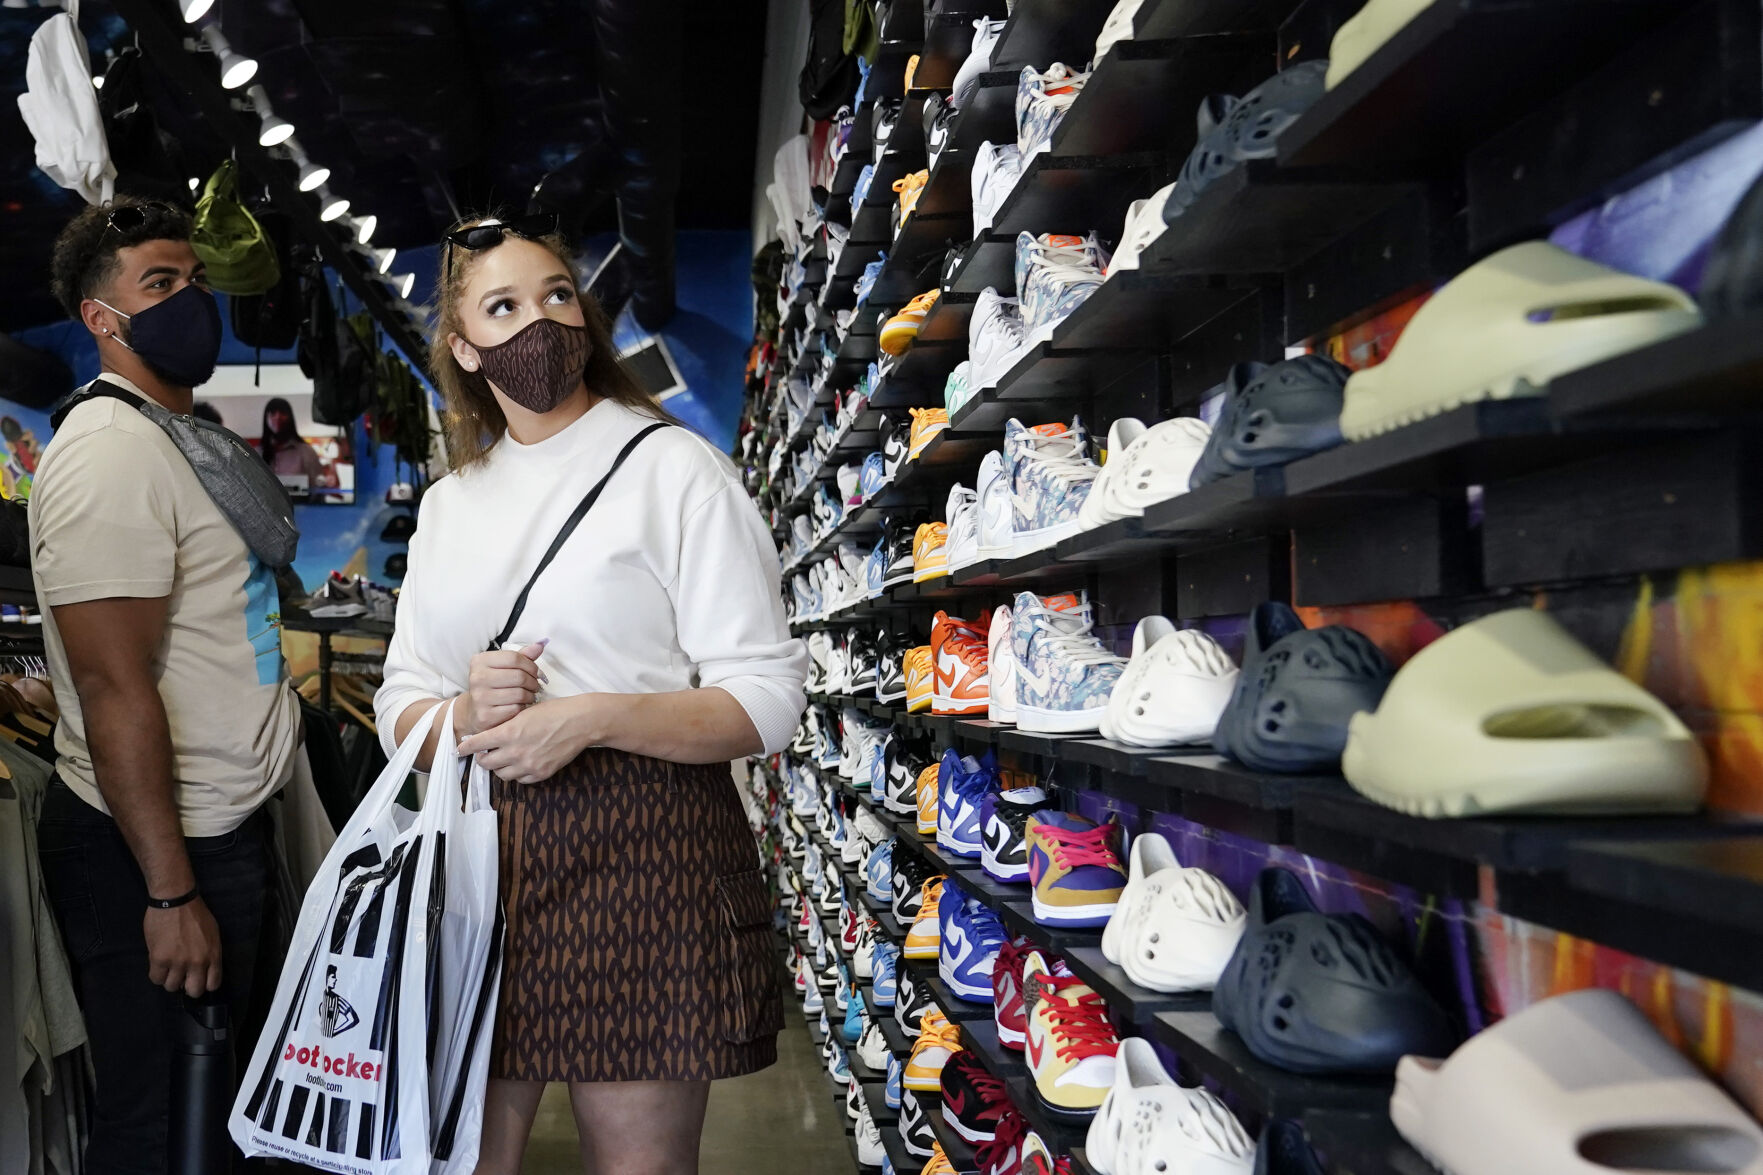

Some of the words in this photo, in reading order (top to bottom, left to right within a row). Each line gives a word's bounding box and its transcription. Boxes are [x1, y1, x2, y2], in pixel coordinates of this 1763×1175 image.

[284, 1043, 320, 1068] oot
[252, 1136, 268, 1147] Please
[269, 1142, 284, 1152] reuse
[291, 1150, 309, 1161] recycle
